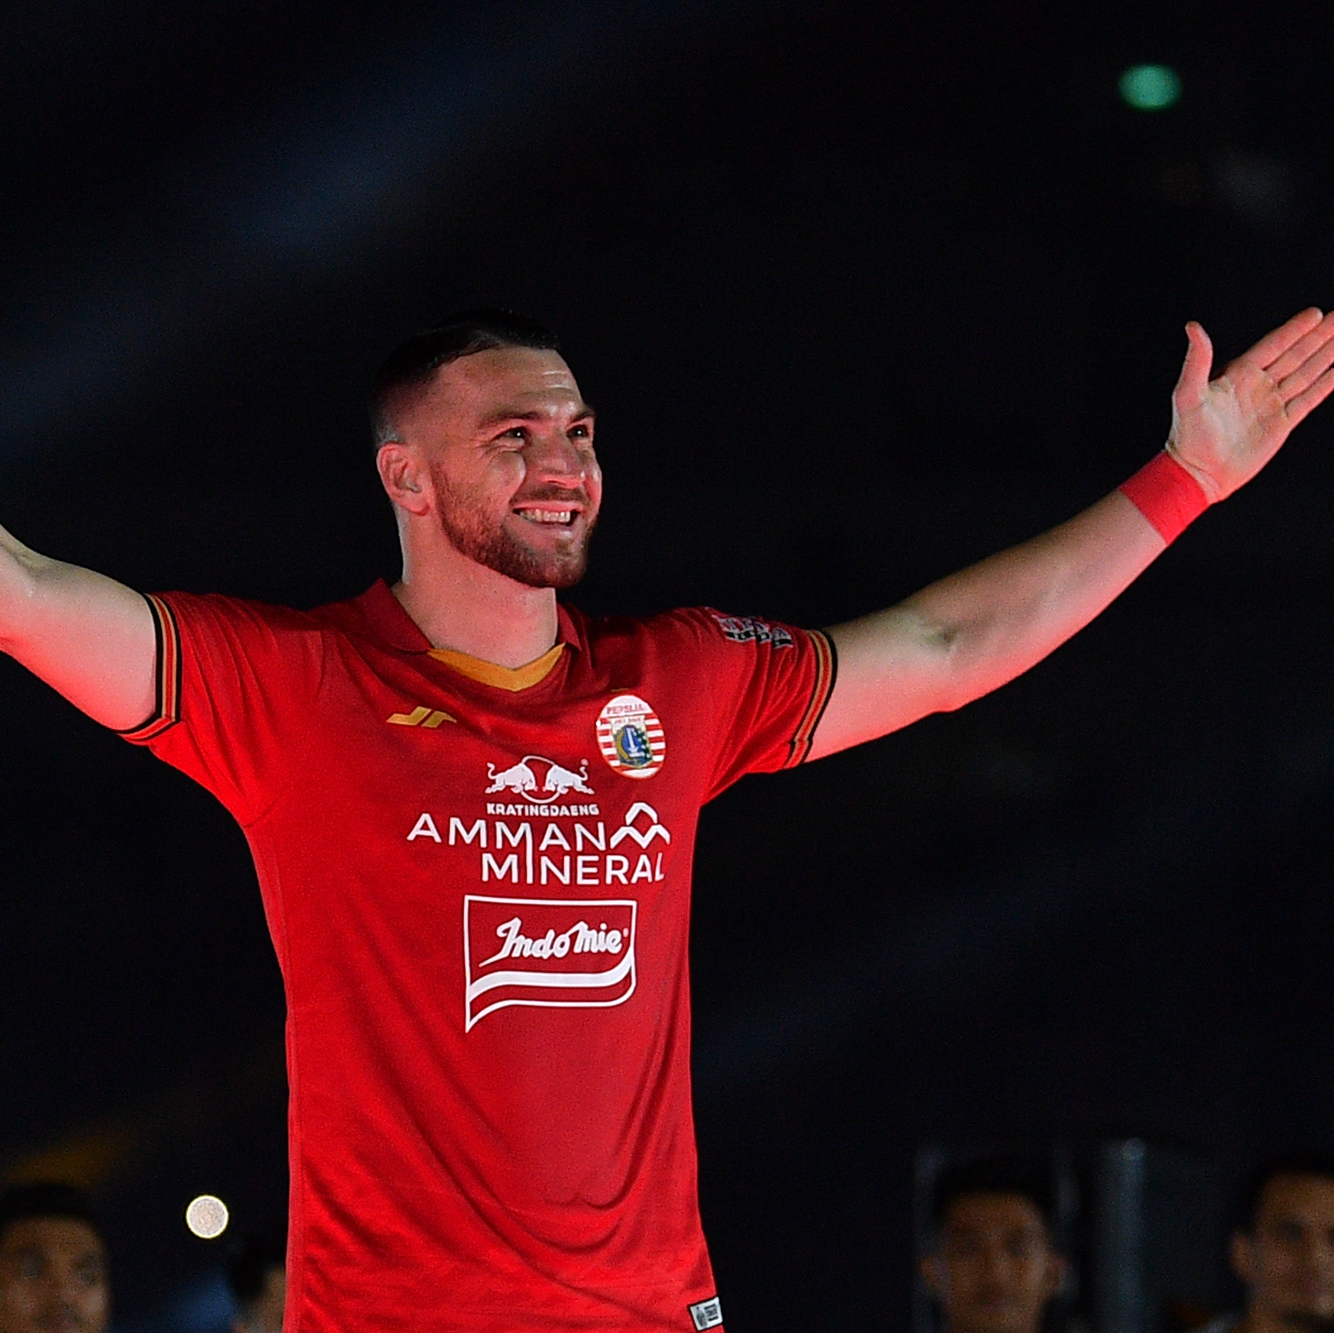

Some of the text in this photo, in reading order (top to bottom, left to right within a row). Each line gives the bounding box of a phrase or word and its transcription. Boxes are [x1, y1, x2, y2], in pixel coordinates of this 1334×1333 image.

[486, 802, 600, 817] KRATINGDAENG
[406, 812, 607, 852] AMMAN
[481, 851, 665, 885] MINERAL
